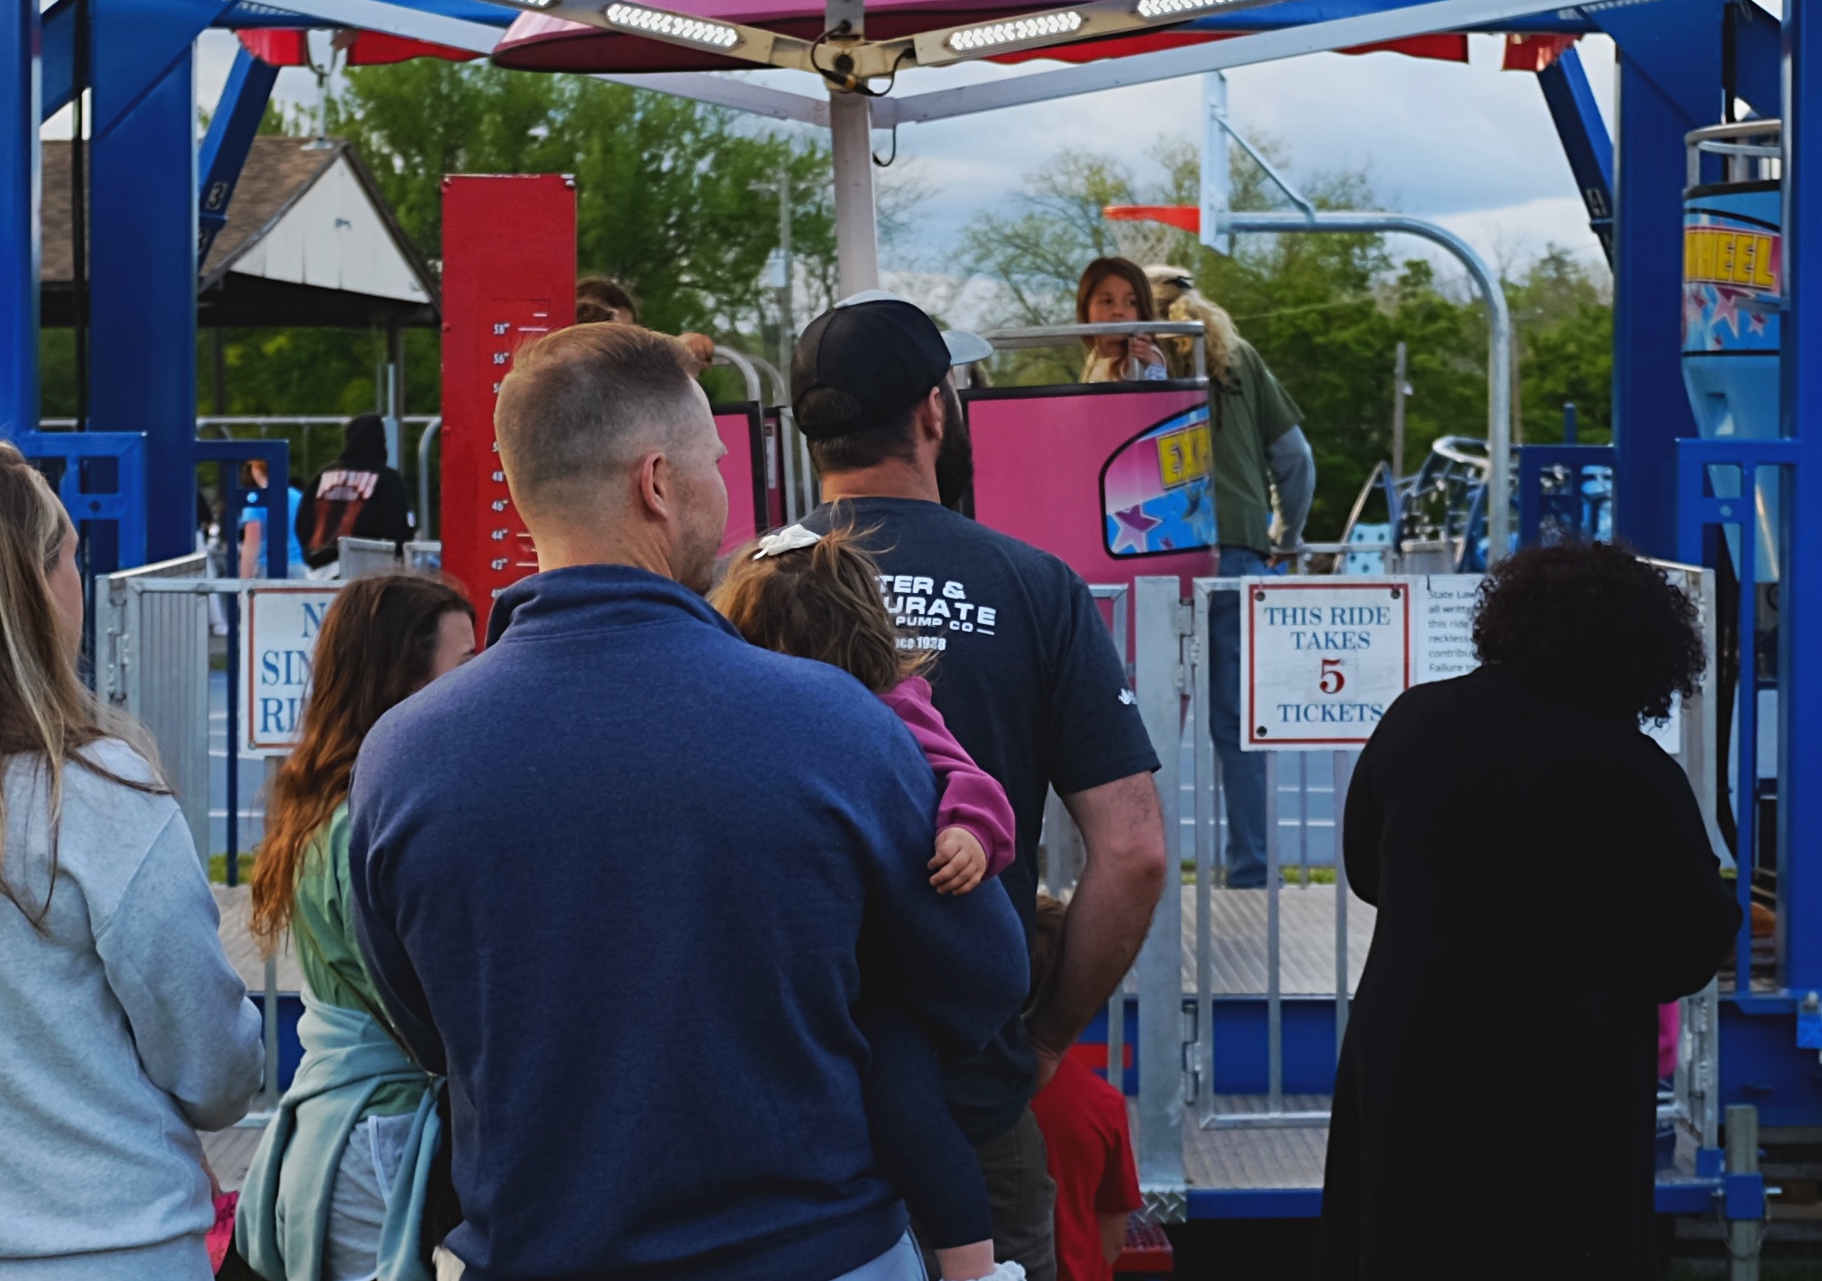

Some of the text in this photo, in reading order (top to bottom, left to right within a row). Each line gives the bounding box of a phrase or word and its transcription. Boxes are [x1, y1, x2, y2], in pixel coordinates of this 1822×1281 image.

[942, 580, 966, 600] &
[895, 616, 943, 627] PUMP
[1264, 606, 1391, 626] THIS RIDE
[1290, 631, 1371, 651] TAKES
[1319, 658, 1346, 695] 5
[1277, 704, 1384, 723] TICKETS
